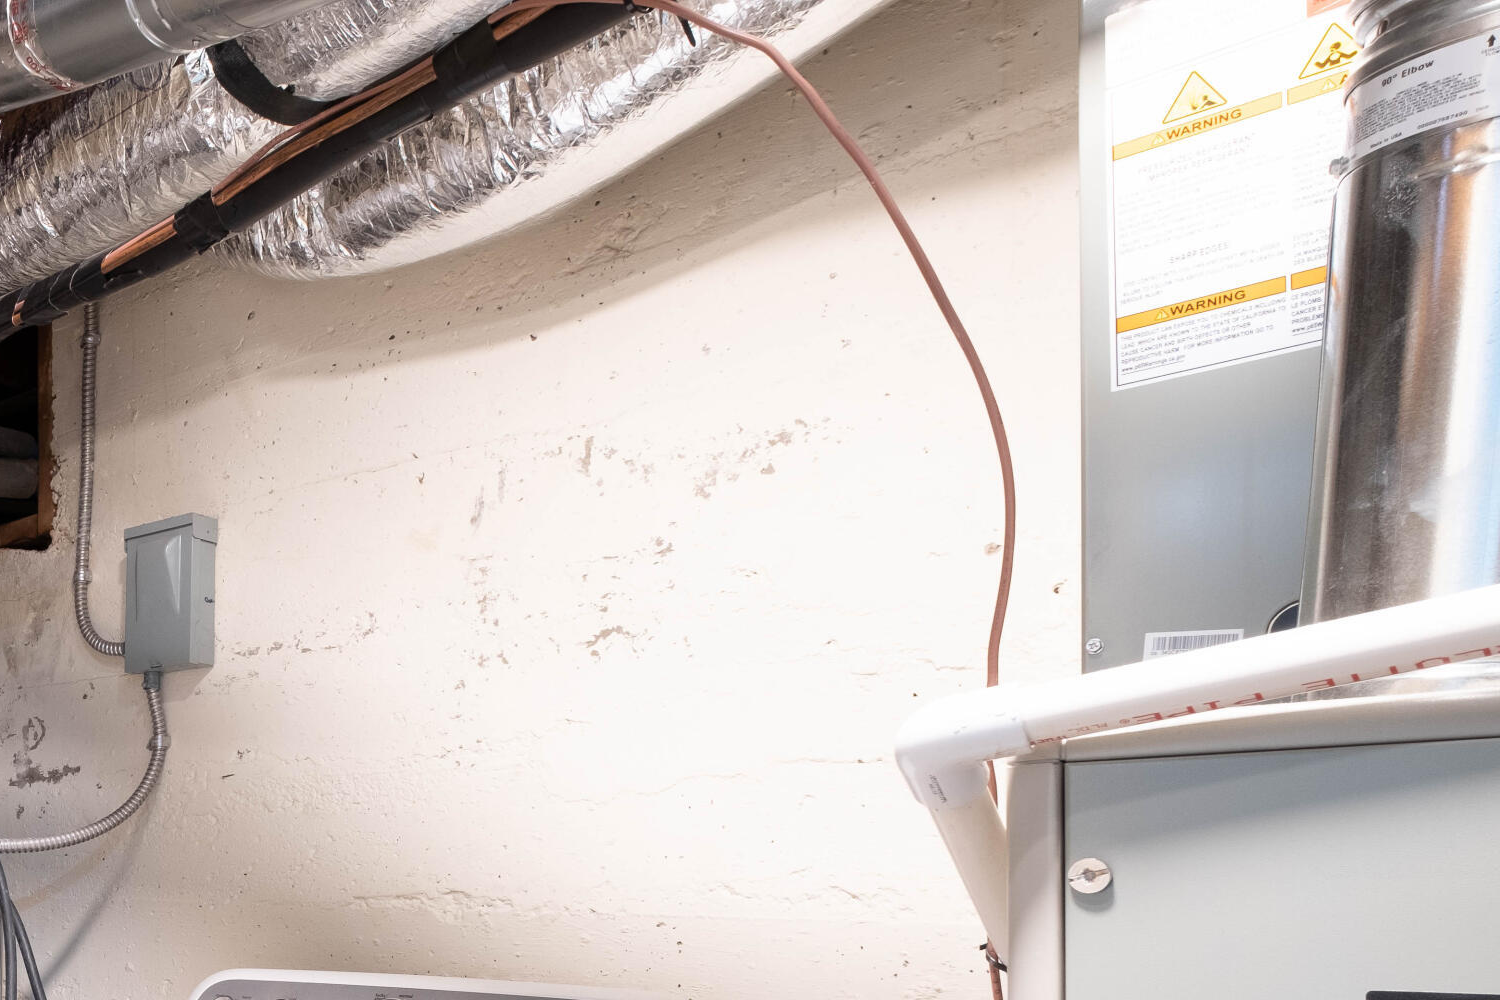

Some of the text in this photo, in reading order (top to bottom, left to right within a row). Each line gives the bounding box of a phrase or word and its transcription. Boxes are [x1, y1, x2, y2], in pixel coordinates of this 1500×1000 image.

[1401, 60, 1434, 78] Elbow
[1166, 108, 1242, 141] WARNING
[1170, 290, 1246, 316] WARNING
